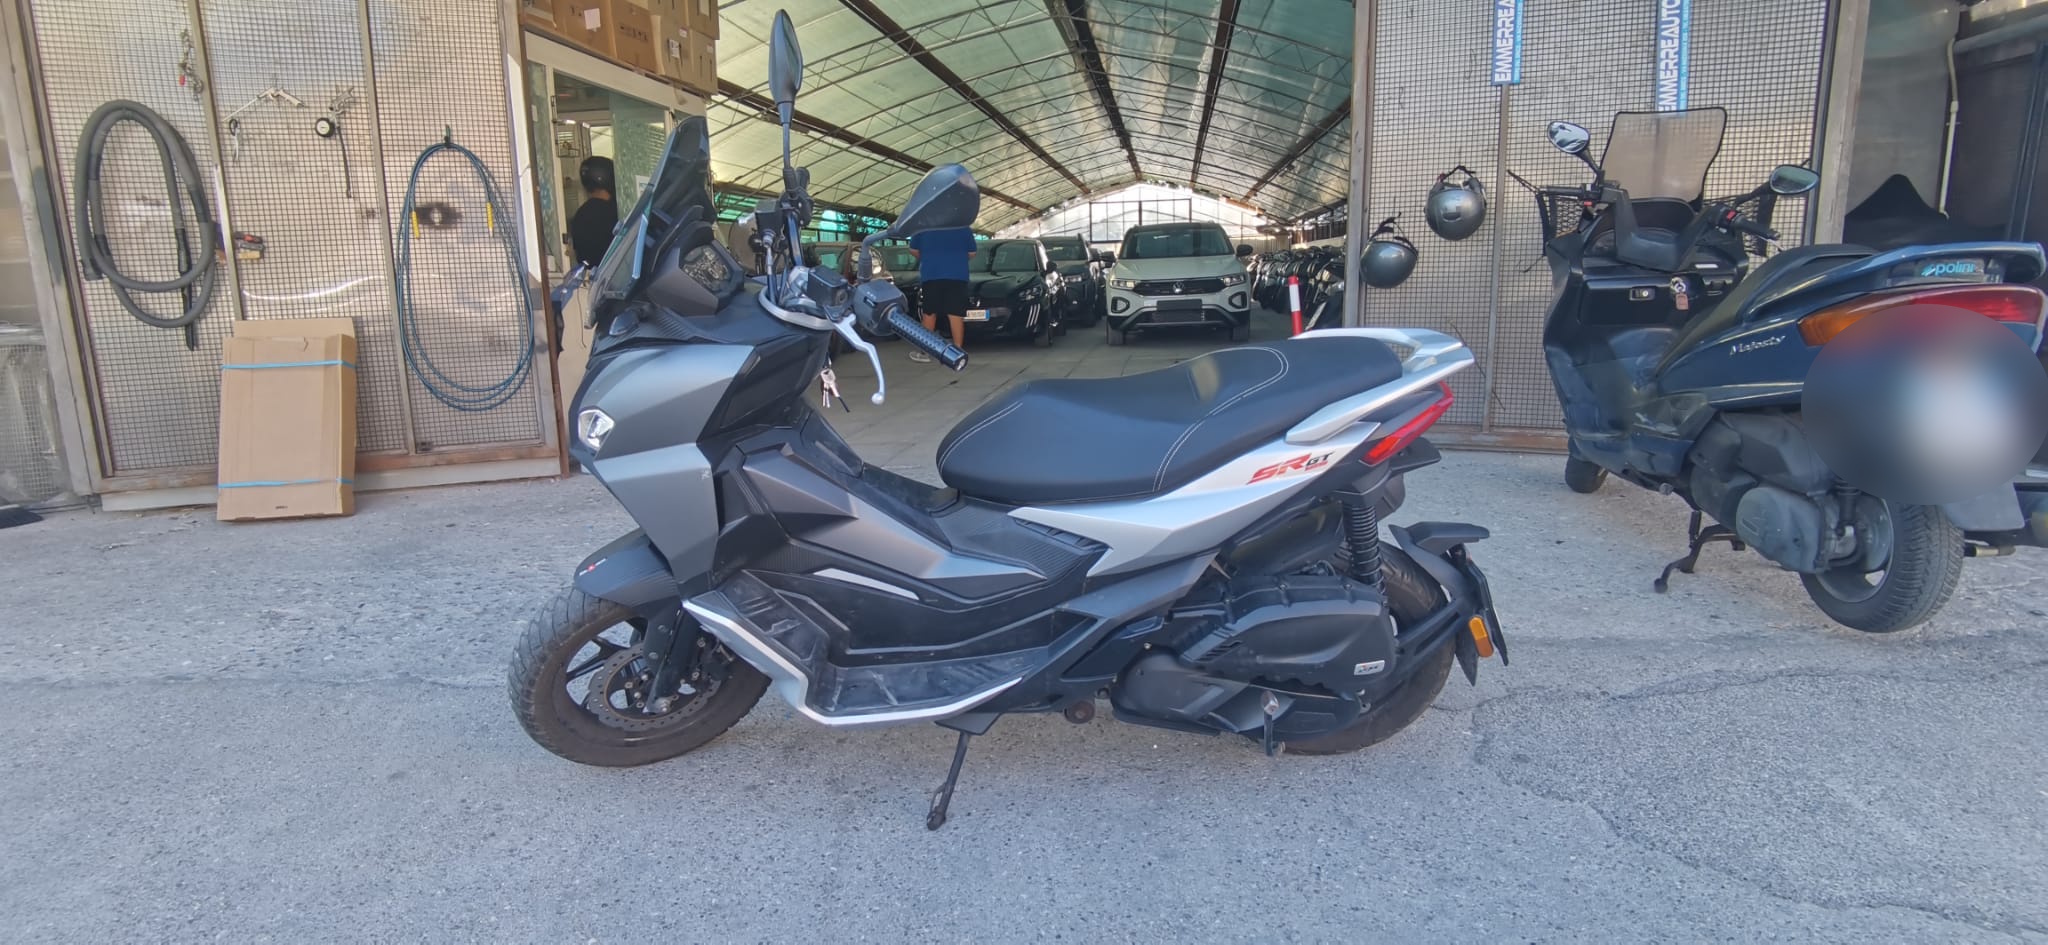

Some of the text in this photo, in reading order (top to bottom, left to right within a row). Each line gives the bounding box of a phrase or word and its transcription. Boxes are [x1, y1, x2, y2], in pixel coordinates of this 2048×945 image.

[1934, 260, 1976, 276] polini
[1247, 453, 1311, 484] SR
[1306, 451, 1335, 466] GT
